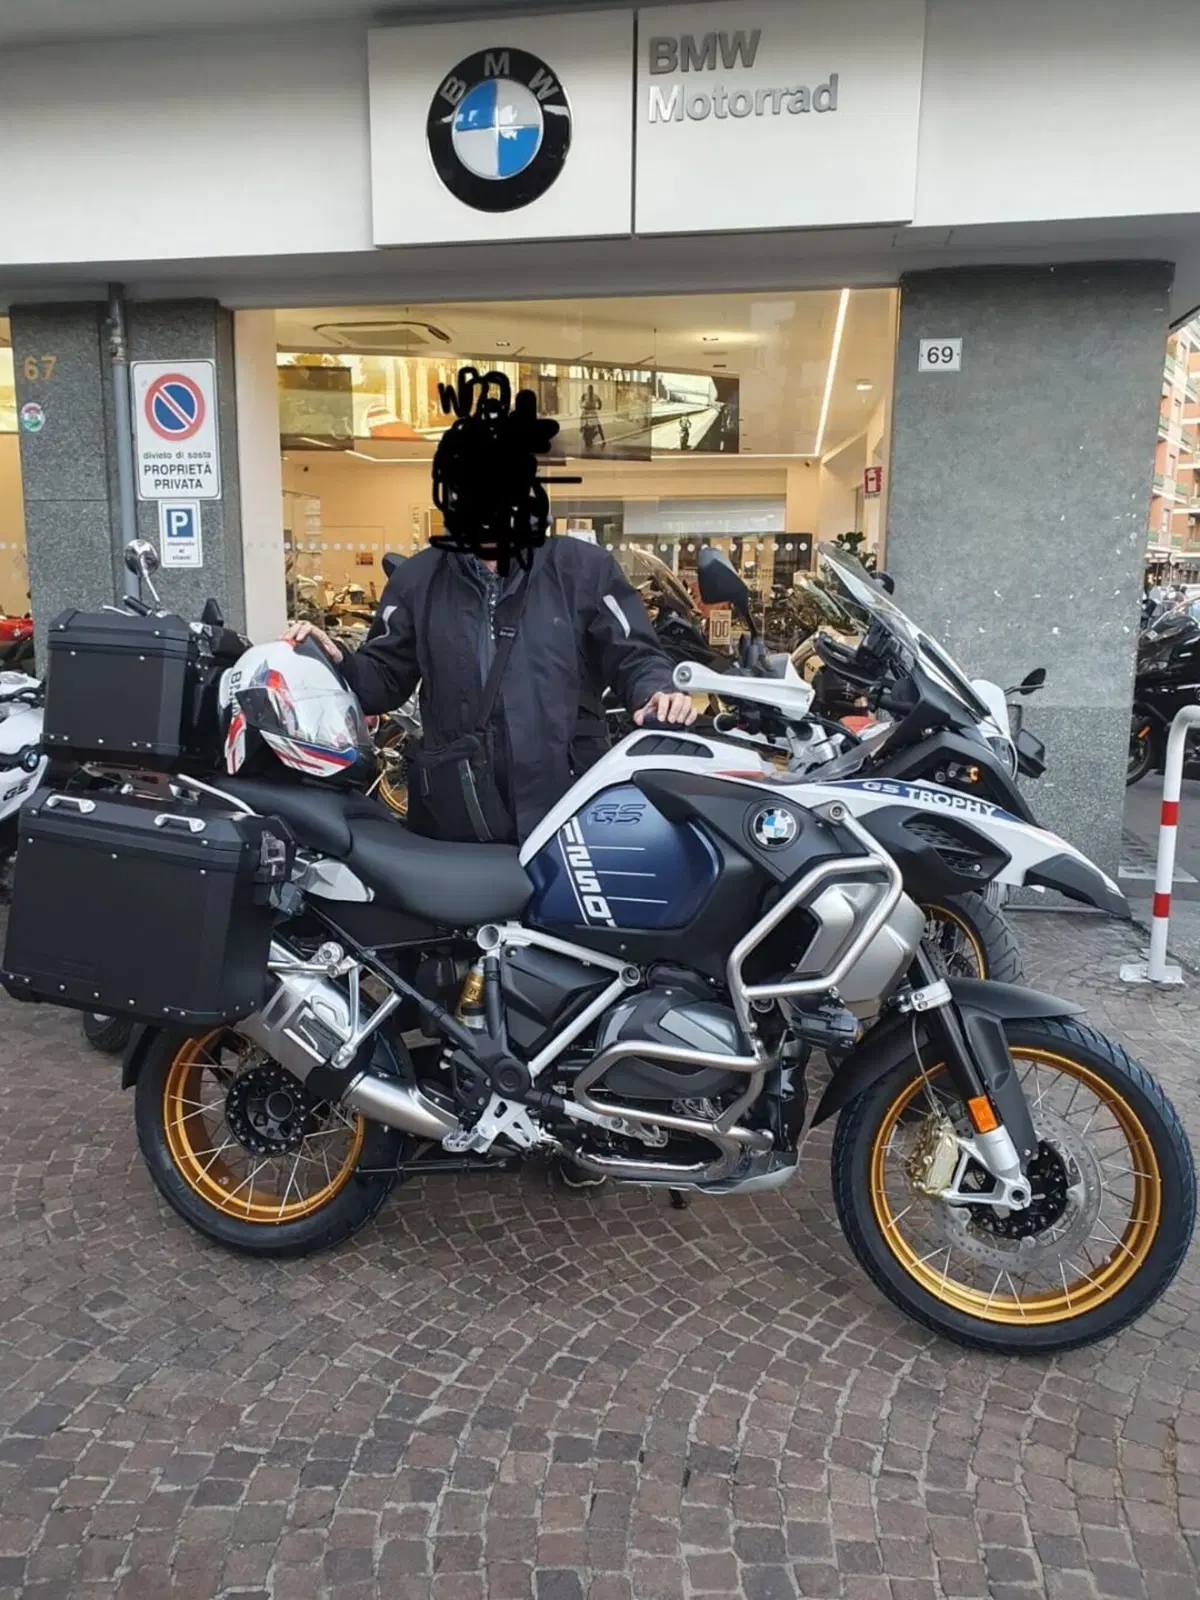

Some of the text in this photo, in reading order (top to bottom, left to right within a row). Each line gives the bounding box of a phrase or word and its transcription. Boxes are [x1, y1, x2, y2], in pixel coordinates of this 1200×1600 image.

[649, 28, 762, 76] BMW
[439, 51, 560, 106] BMW
[649, 72, 839, 123] Motorrad
[927, 346, 953, 364] 69
[23, 354, 57, 382] 67
[175, 451, 184, 460] di
[187, 451, 212, 459] sosta
[143, 461, 212, 476] PROPRIETÀ
[154, 478, 204, 490] PRIVATA
[171, 511, 188, 535] P
[862, 781, 997, 816] GS TROPHY
[589, 803, 647, 826] GS
